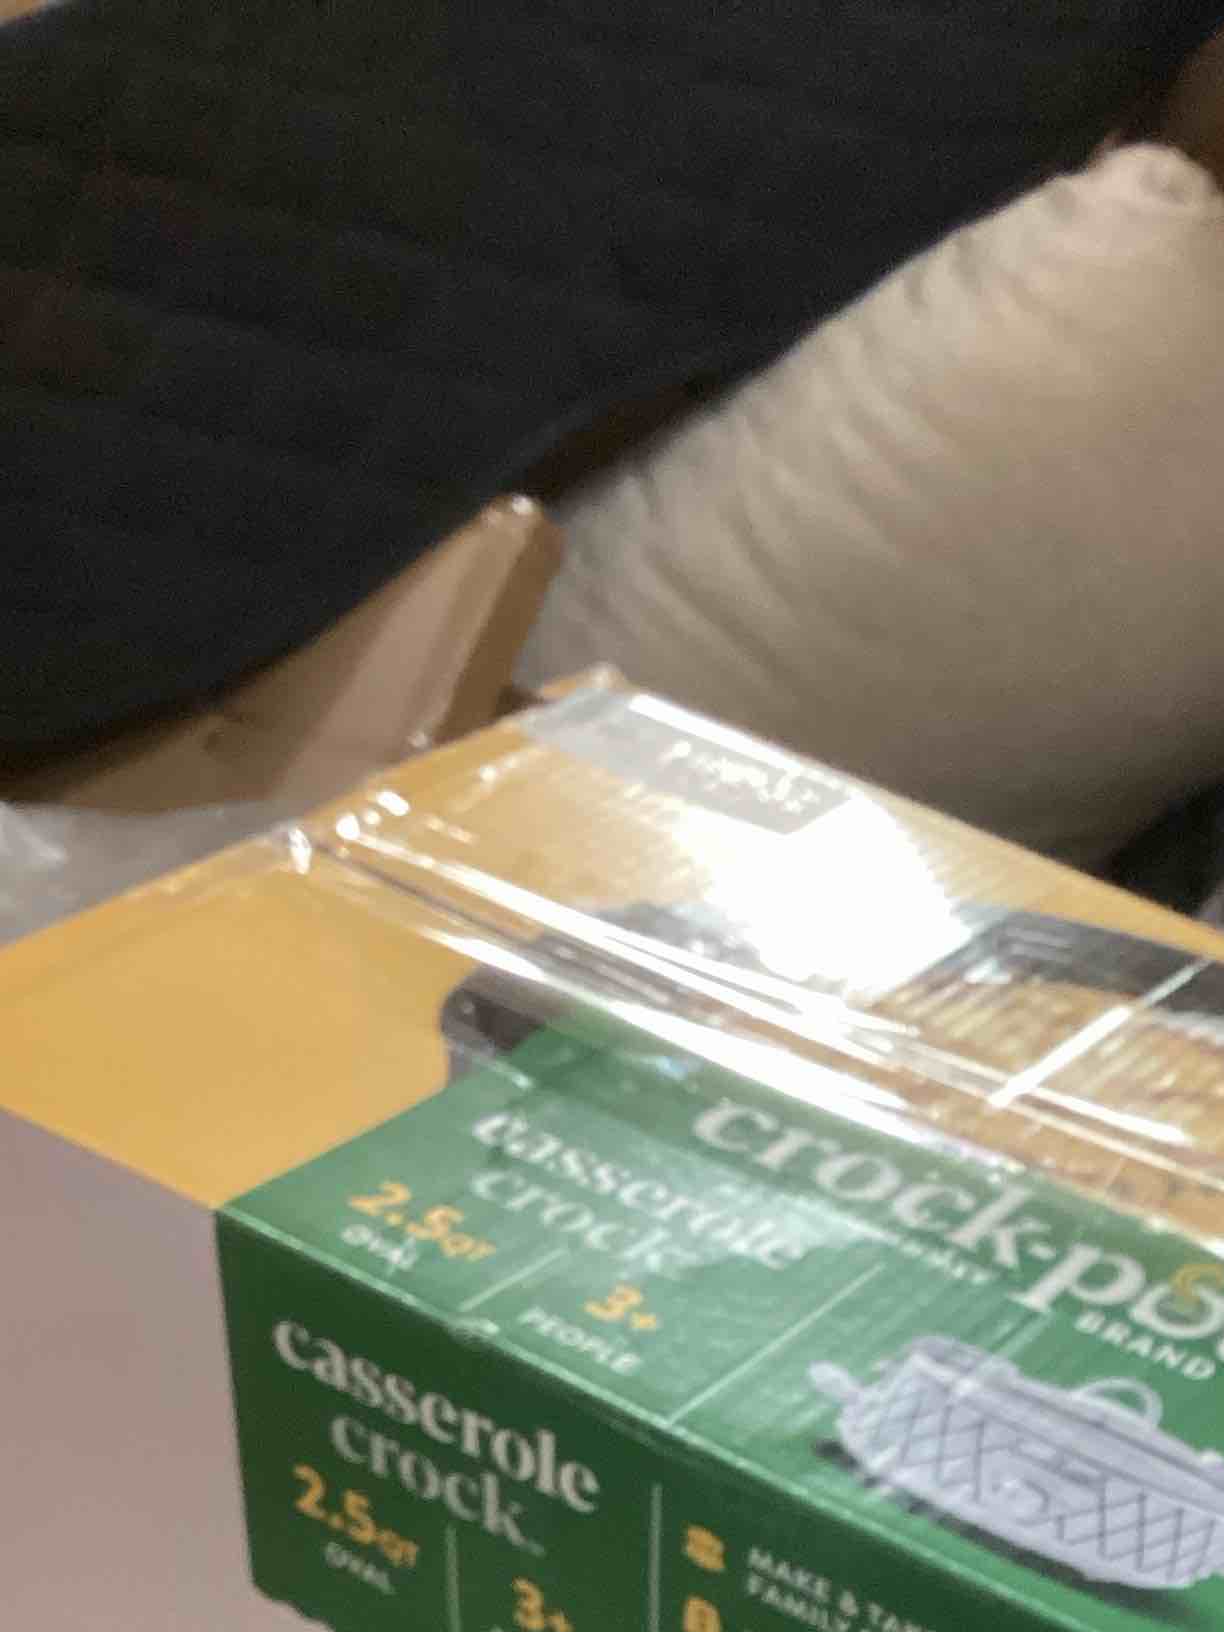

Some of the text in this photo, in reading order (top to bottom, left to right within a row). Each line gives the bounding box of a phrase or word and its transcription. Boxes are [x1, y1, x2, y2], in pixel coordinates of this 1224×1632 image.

[472, 1112, 808, 1271] casserole
[1074, 1312, 1216, 1381] BRAND
[272, 1320, 600, 1513] casserole
[330, 1414, 530, 1548] crock
[747, 1547, 832, 1602] MAKE
